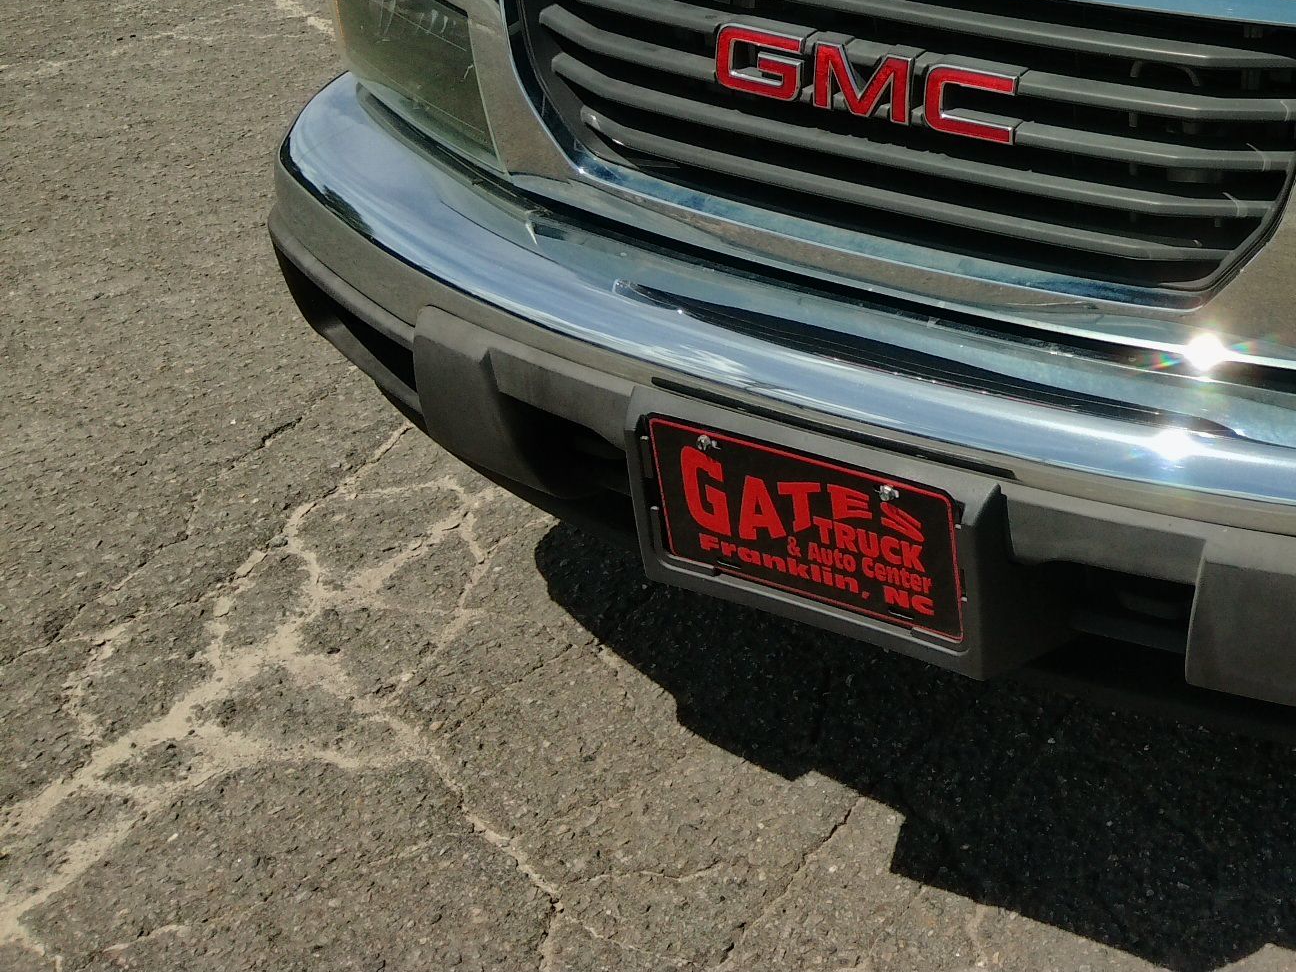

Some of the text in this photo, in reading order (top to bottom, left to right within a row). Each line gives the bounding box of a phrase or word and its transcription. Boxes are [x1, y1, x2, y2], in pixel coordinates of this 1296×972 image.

[715, 23, 1019, 145] GMC
[681, 446, 925, 543] GATES
[787, 536, 932, 594] & Auto Center
[813, 516, 926, 573] TRUCK
[883, 585, 935, 616] NC
